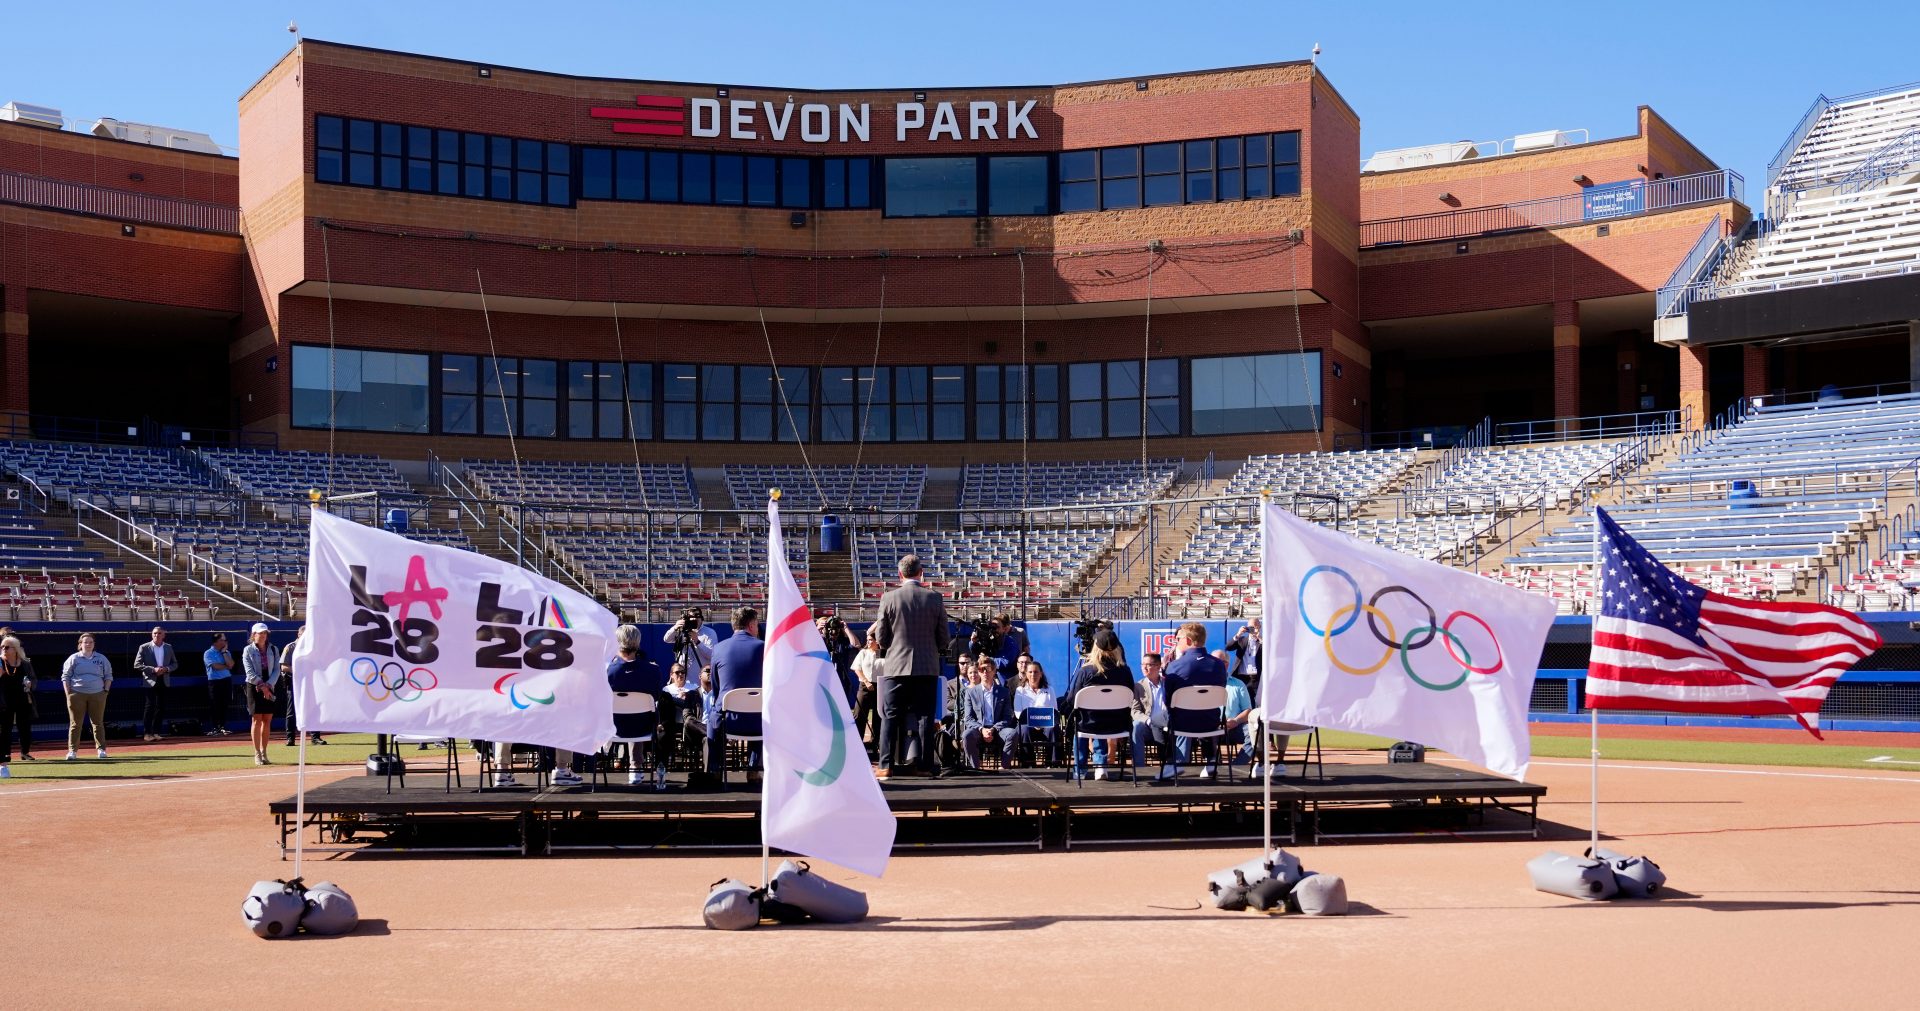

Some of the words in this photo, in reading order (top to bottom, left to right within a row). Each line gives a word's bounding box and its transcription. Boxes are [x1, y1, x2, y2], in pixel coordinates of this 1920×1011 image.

[691, 97, 870, 143] DEVON
[896, 100, 1039, 142] PARK
[349, 556, 448, 621] LA
[351, 609, 439, 665] 28
[476, 625, 574, 671] 28
[1145, 634, 1177, 655] US
